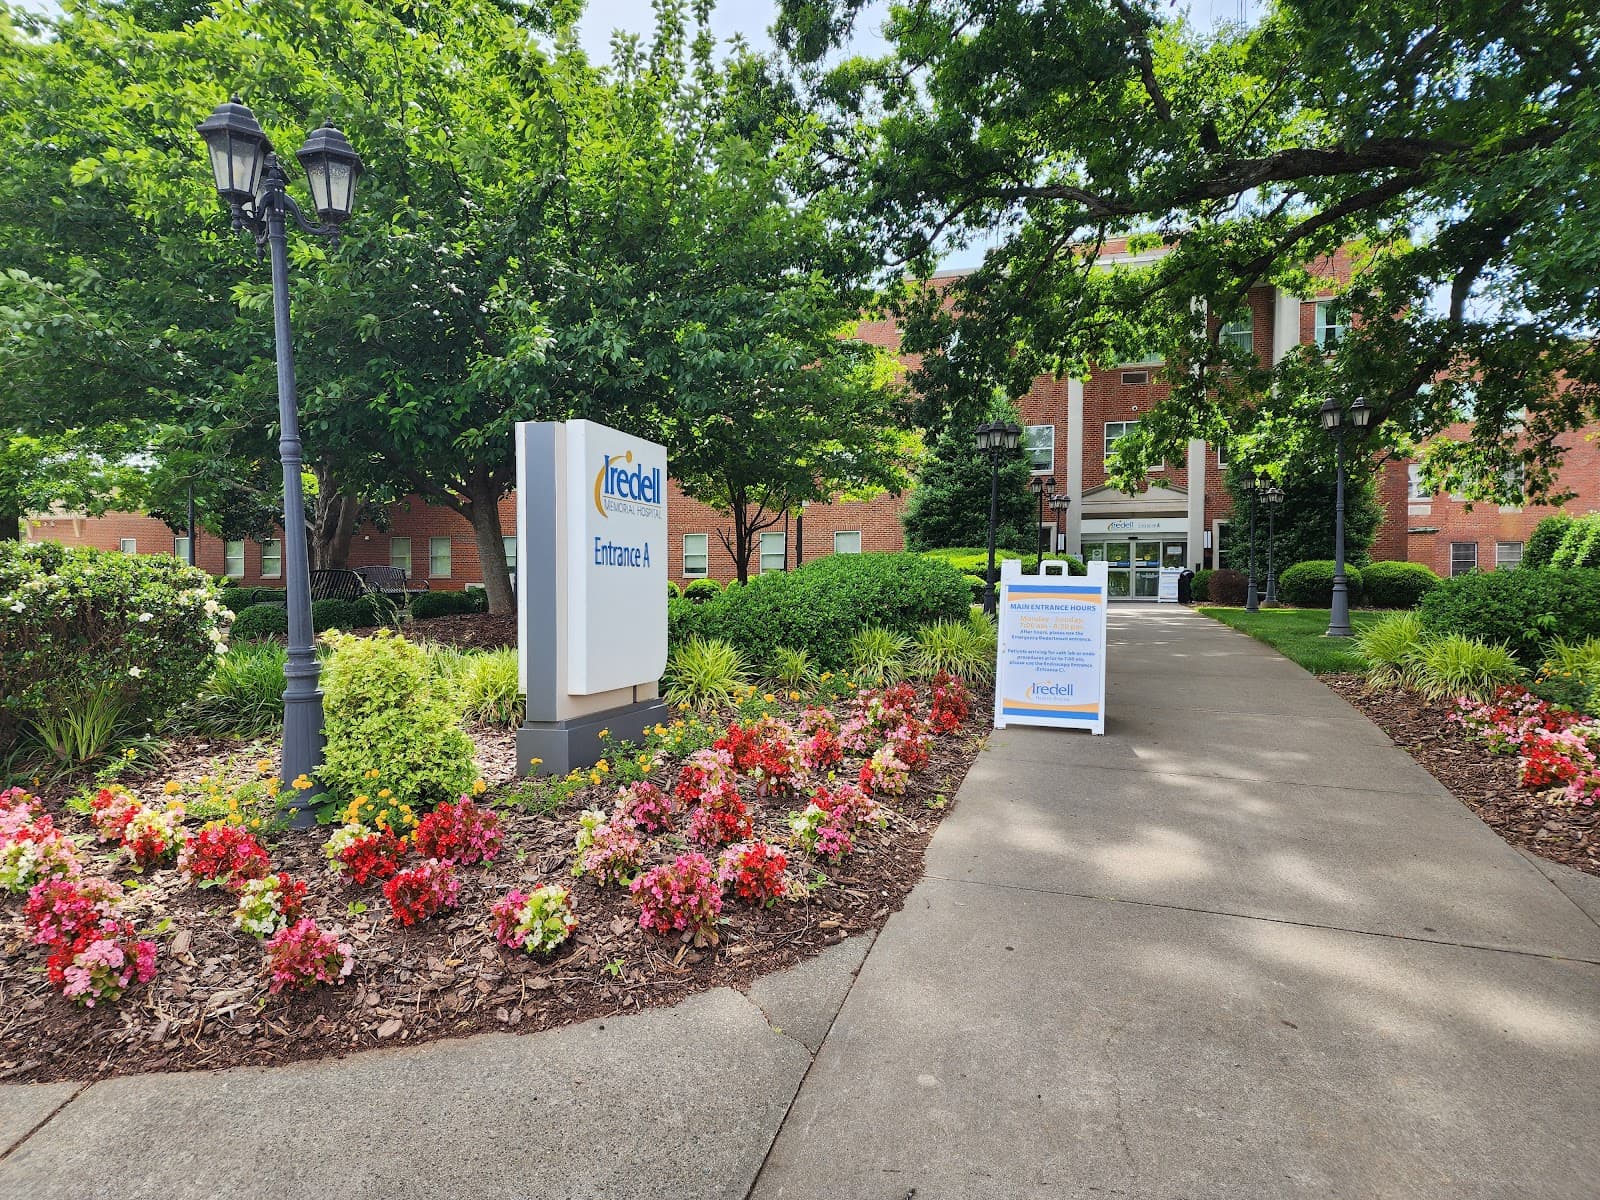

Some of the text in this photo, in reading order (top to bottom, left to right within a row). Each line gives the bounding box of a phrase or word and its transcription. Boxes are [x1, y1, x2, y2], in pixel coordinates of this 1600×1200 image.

[603, 454, 661, 504] Iredell
[603, 499, 662, 520] MEMORIAL HOSPITAL
[594, 536, 650, 568] Entrance A
[1070, 604, 1097, 612] HOURS
[1032, 682, 1073, 696] Iredell
